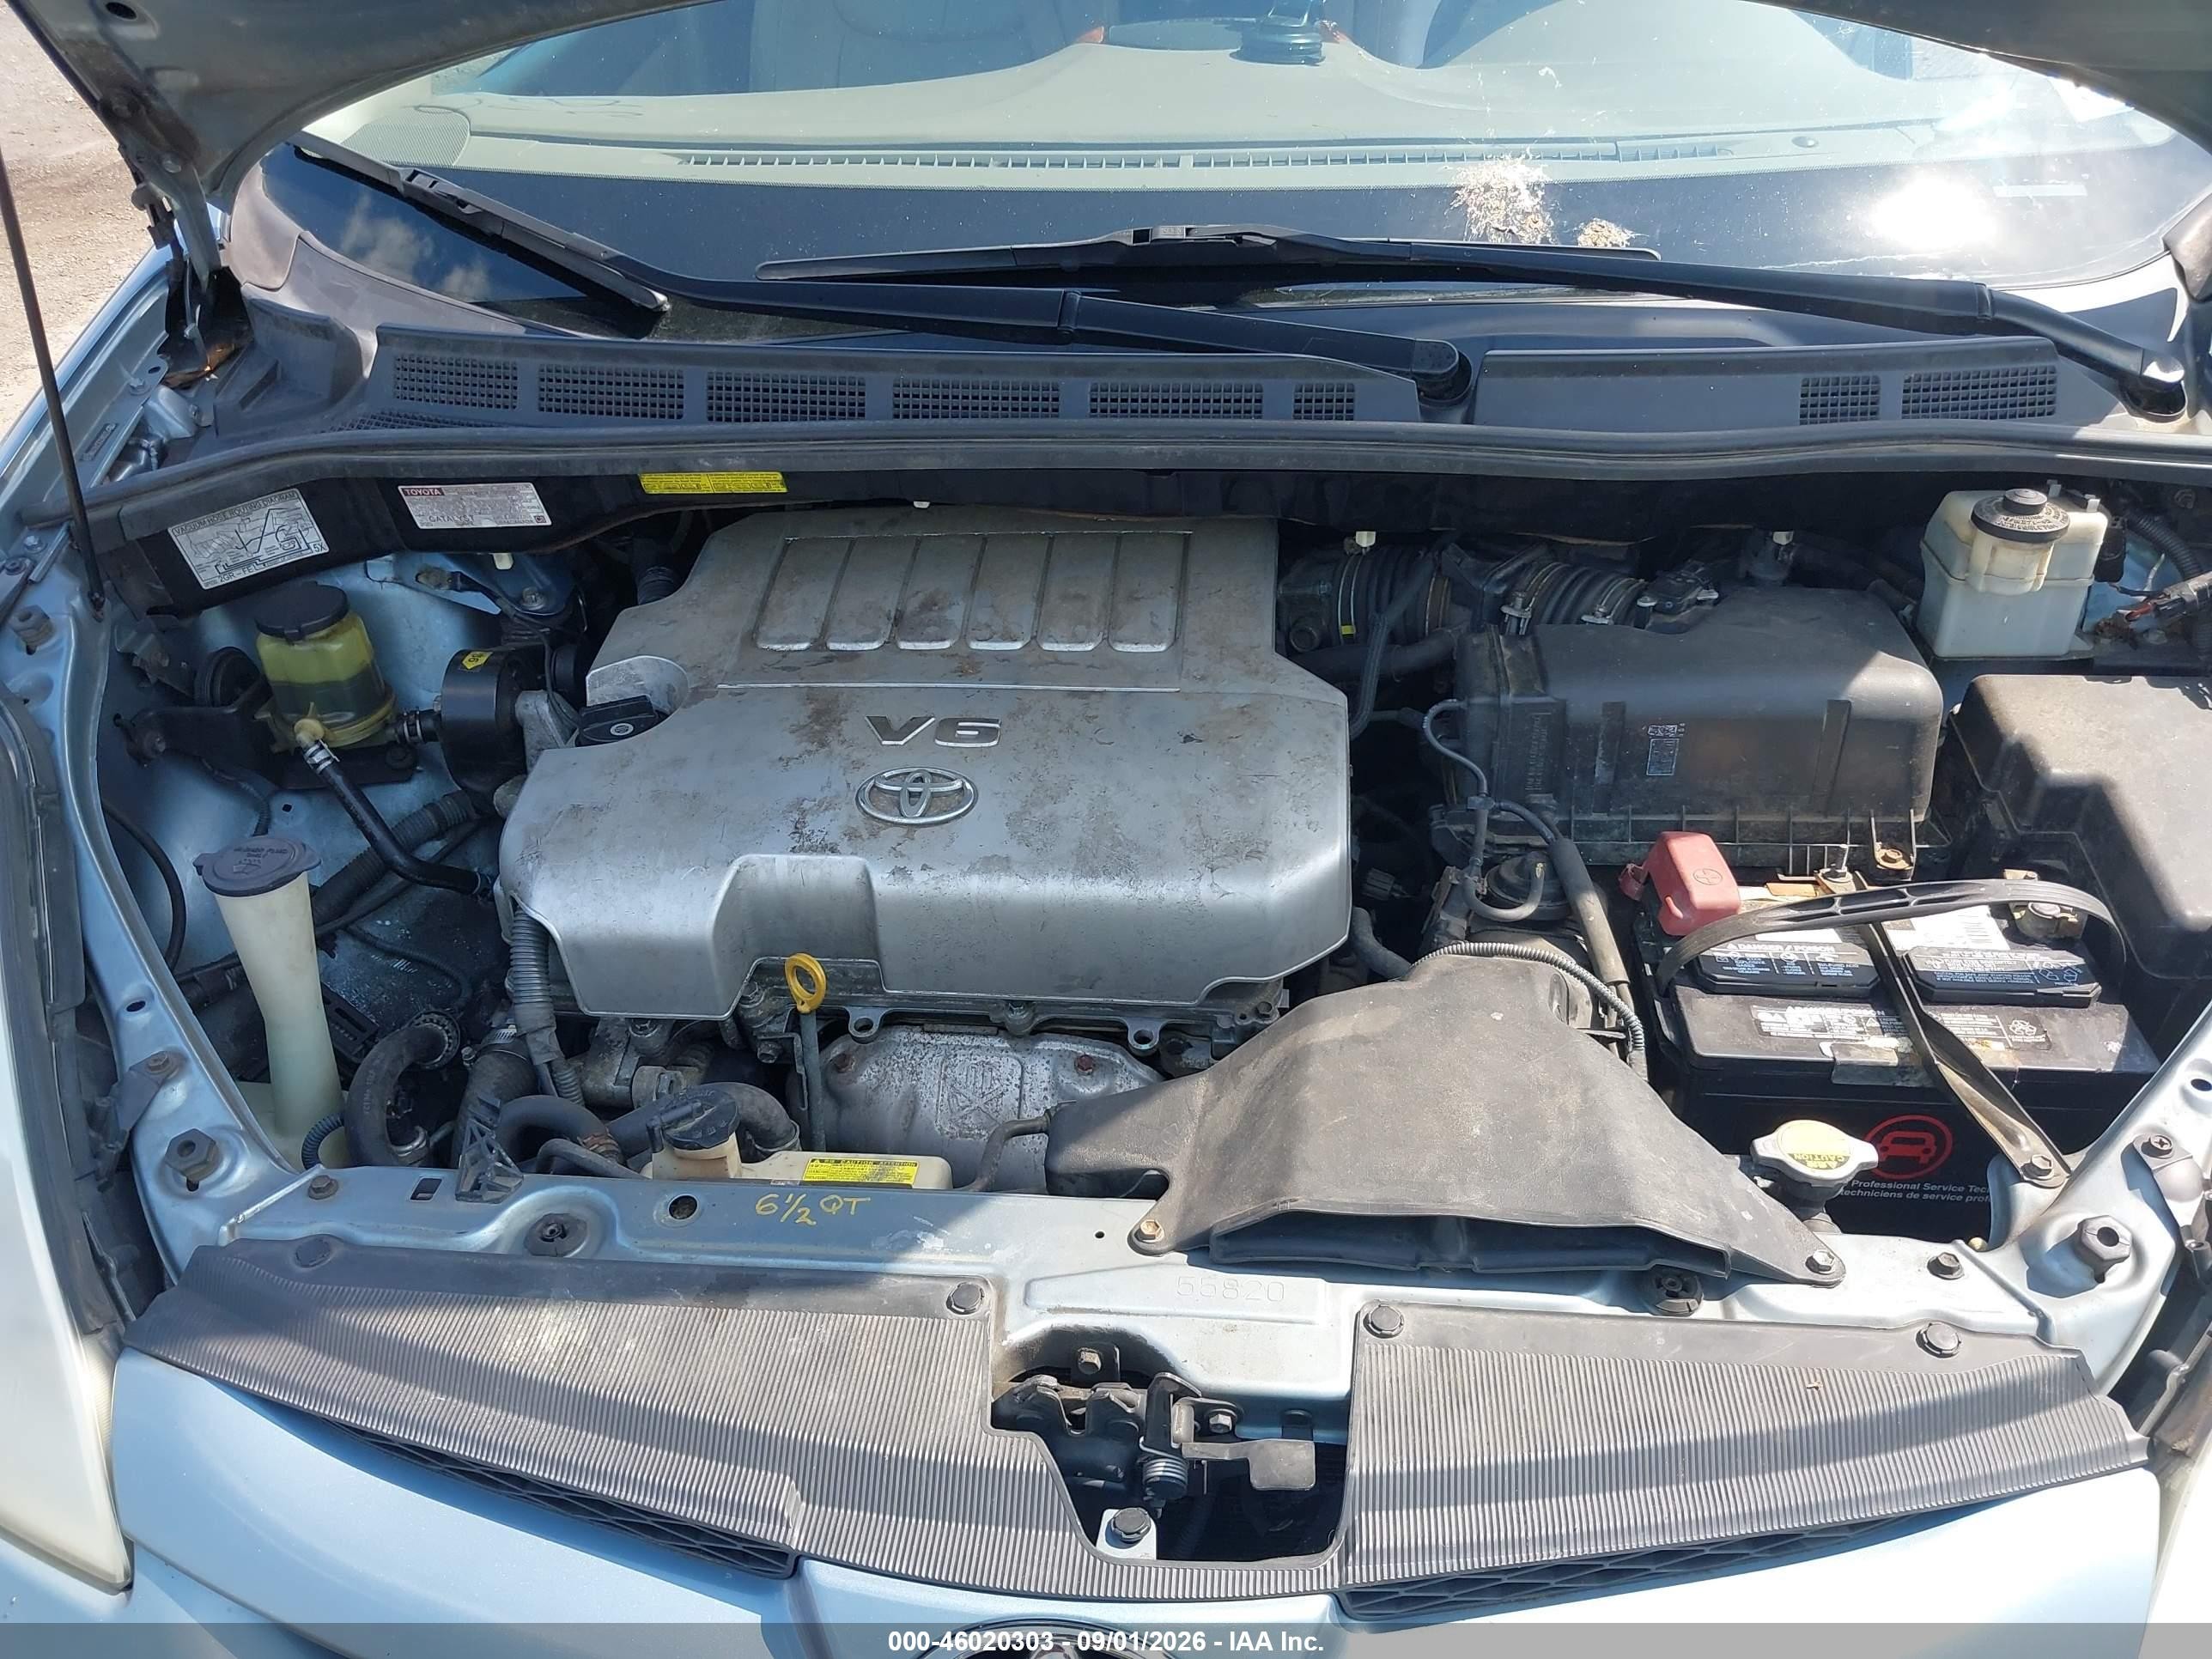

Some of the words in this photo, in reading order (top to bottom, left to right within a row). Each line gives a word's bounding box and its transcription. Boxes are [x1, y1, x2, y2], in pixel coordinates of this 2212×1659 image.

[173, 518, 209, 536] VACUUM
[209, 513, 228, 526] HOSE
[228, 501, 264, 518] ROUTING
[264, 492, 296, 507] DIAGRAM
[313, 543, 328, 553] 5X
[865, 716, 1001, 748] V6
[1793, 1153, 1845, 1162] CAUTION
[1851, 1180, 1921, 1190] Professional
[1923, 1182, 1965, 1192] Service
[819, 1194, 872, 1215] QT
[1922, 1193, 1963, 1201] service
[1176, 1276, 1285, 1302] 55820
